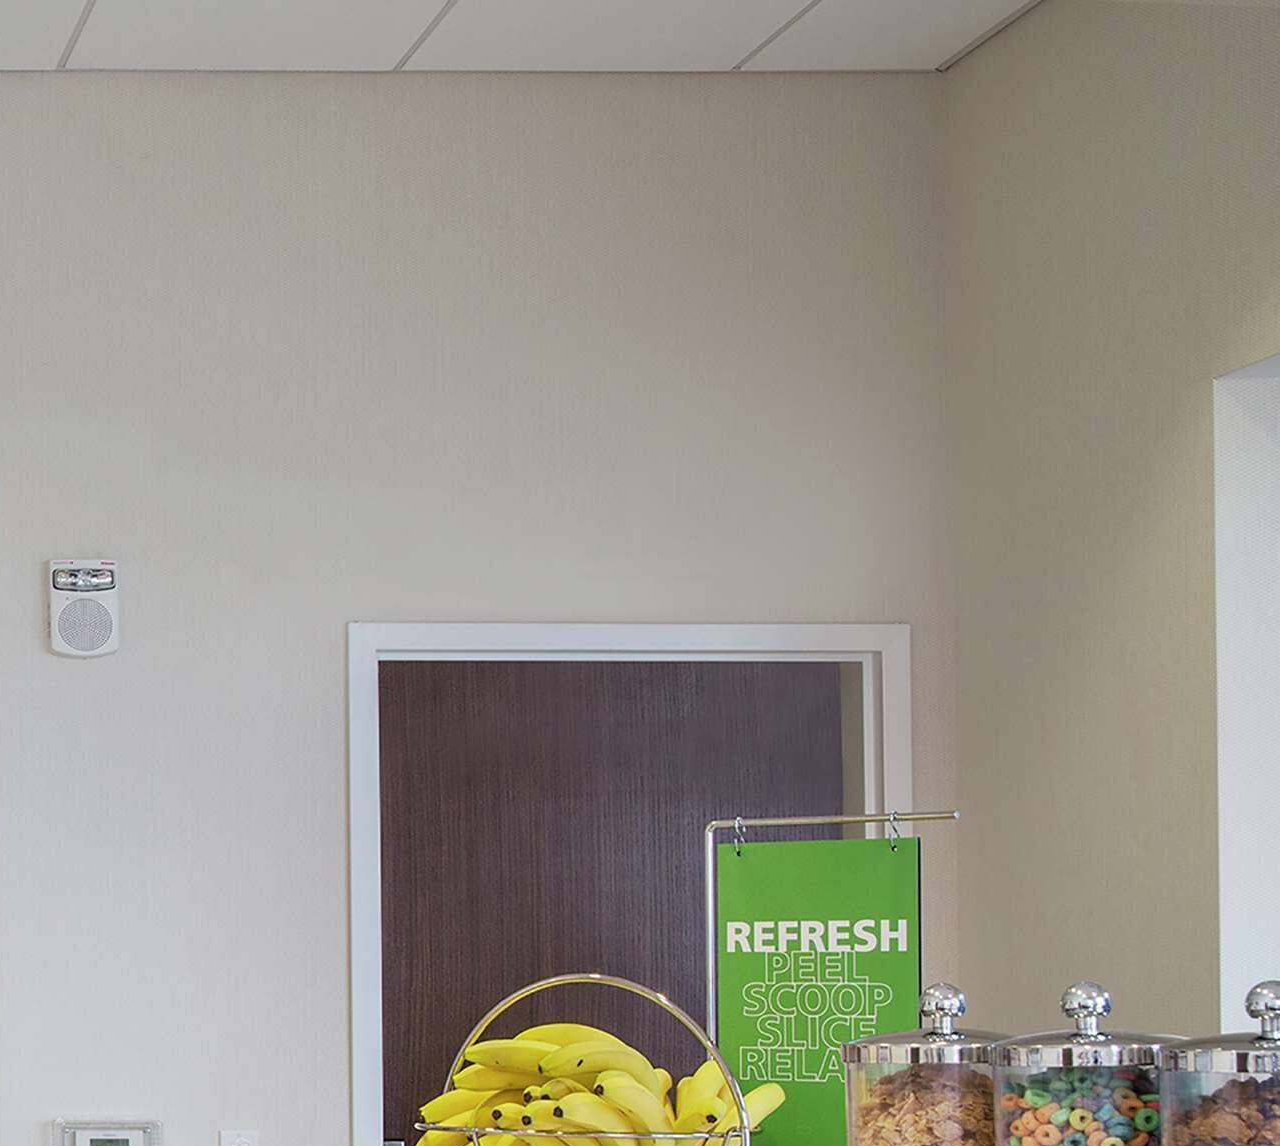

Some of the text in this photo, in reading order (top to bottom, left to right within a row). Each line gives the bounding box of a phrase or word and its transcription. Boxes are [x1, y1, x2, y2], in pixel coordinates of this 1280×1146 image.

[726, 919, 908, 952] REFRESH
[765, 951, 869, 984] PEEL
[742, 982, 893, 1017] SCOOP
[757, 1014, 876, 1049] SLICE
[739, 1046, 846, 1082] RELA
